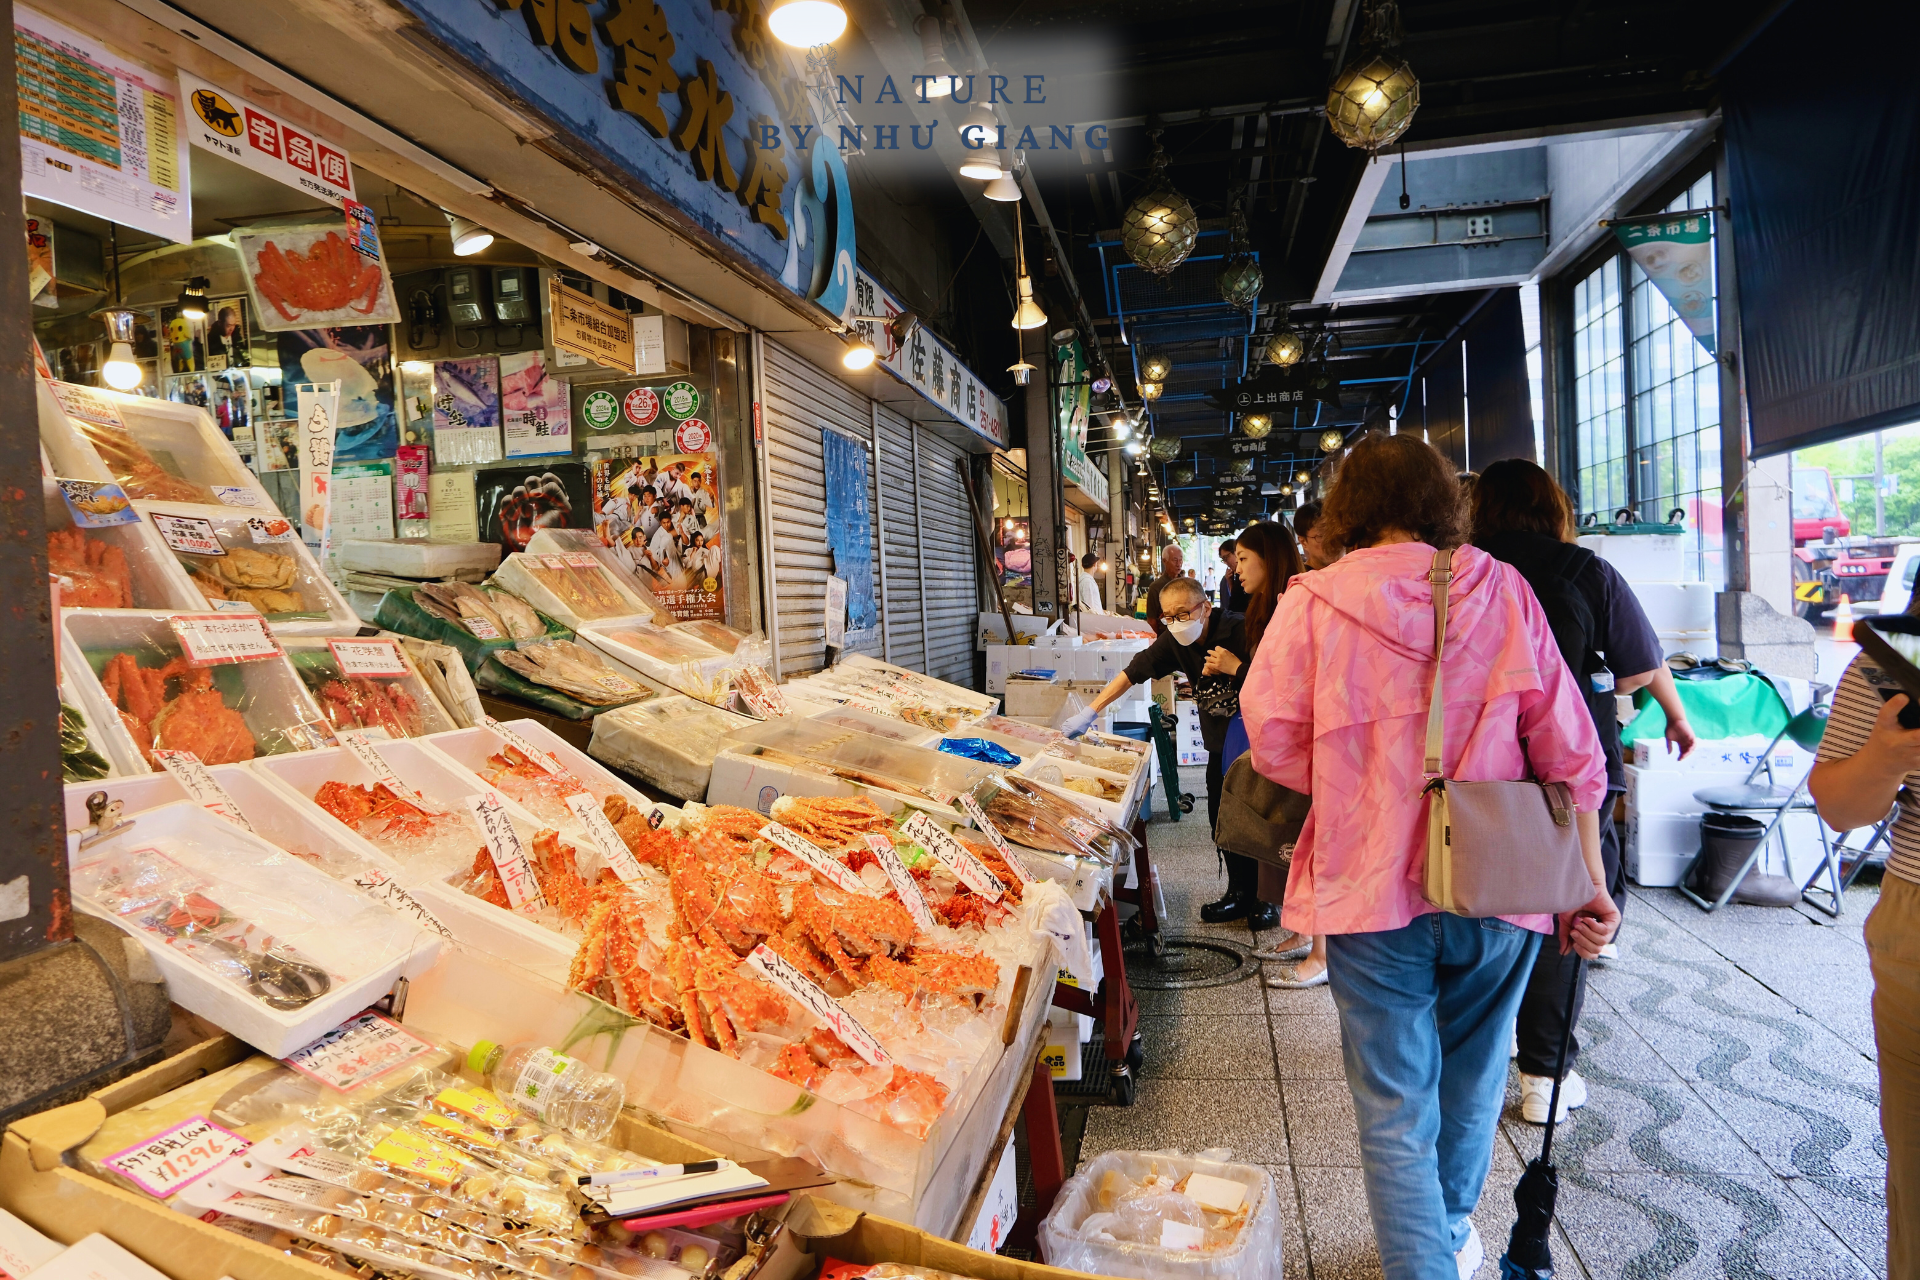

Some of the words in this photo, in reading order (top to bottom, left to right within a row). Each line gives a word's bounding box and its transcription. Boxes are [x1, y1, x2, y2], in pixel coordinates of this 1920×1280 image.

[203, 133, 242, 157] ヤマト運輸
[250, 117, 346, 185] 宅急便
[1627, 218, 1700, 238] 二条市場
[563, 305, 628, 344] 二条市場組合加盟店
[908, 320, 977, 422] 佐藤商店
[1253, 390, 1304, 404] 上出商店
[522, 410, 550, 437] 時鮭
[352, 645, 386, 658] 花咲蟹
[1043, 1053, 1066, 1068] 食品
[411, 1156, 455, 1178] 帆立
